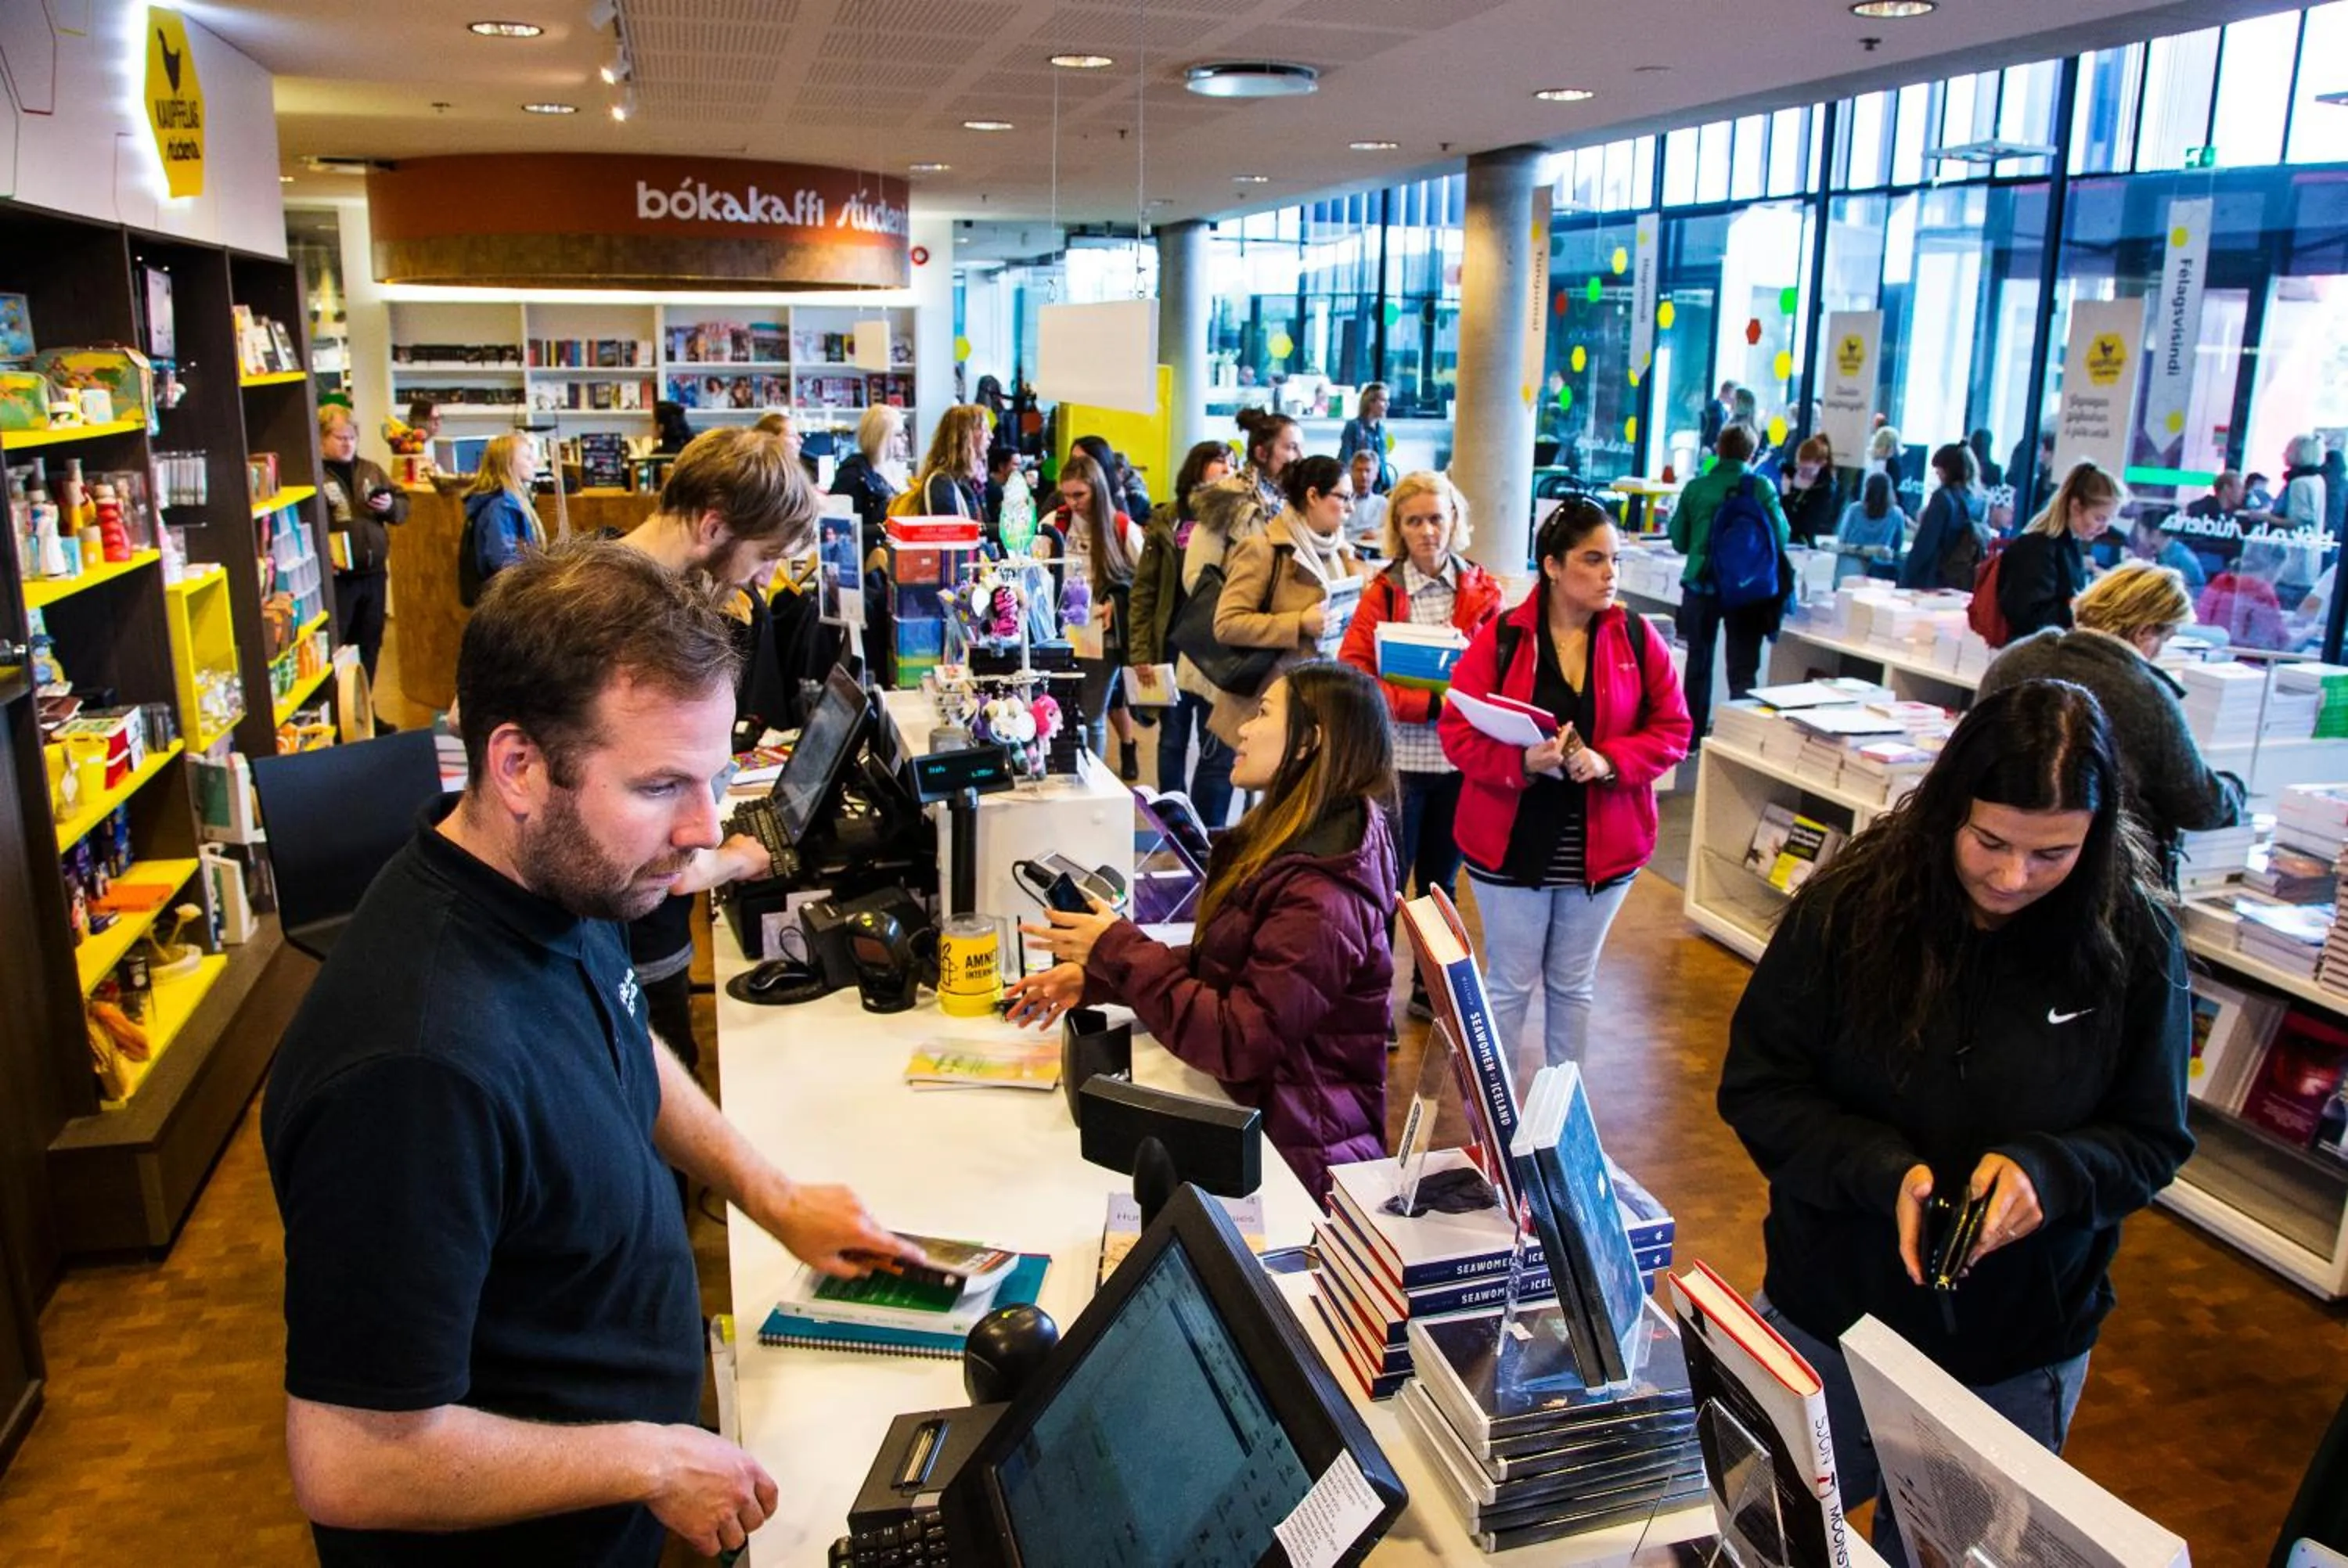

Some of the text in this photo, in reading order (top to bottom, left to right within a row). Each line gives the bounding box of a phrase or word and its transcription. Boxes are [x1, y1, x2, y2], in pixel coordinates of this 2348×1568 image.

[636, 176, 824, 227] bókakaffi
[1470, 1011, 1496, 1070] SEAWOMEN
[1490, 1082, 1511, 1126] ICELAND
[1529, 1251, 1545, 1264] ICE
[1461, 1286, 1507, 1304] SEAWOM
[1530, 1278, 1554, 1289] ICEL
